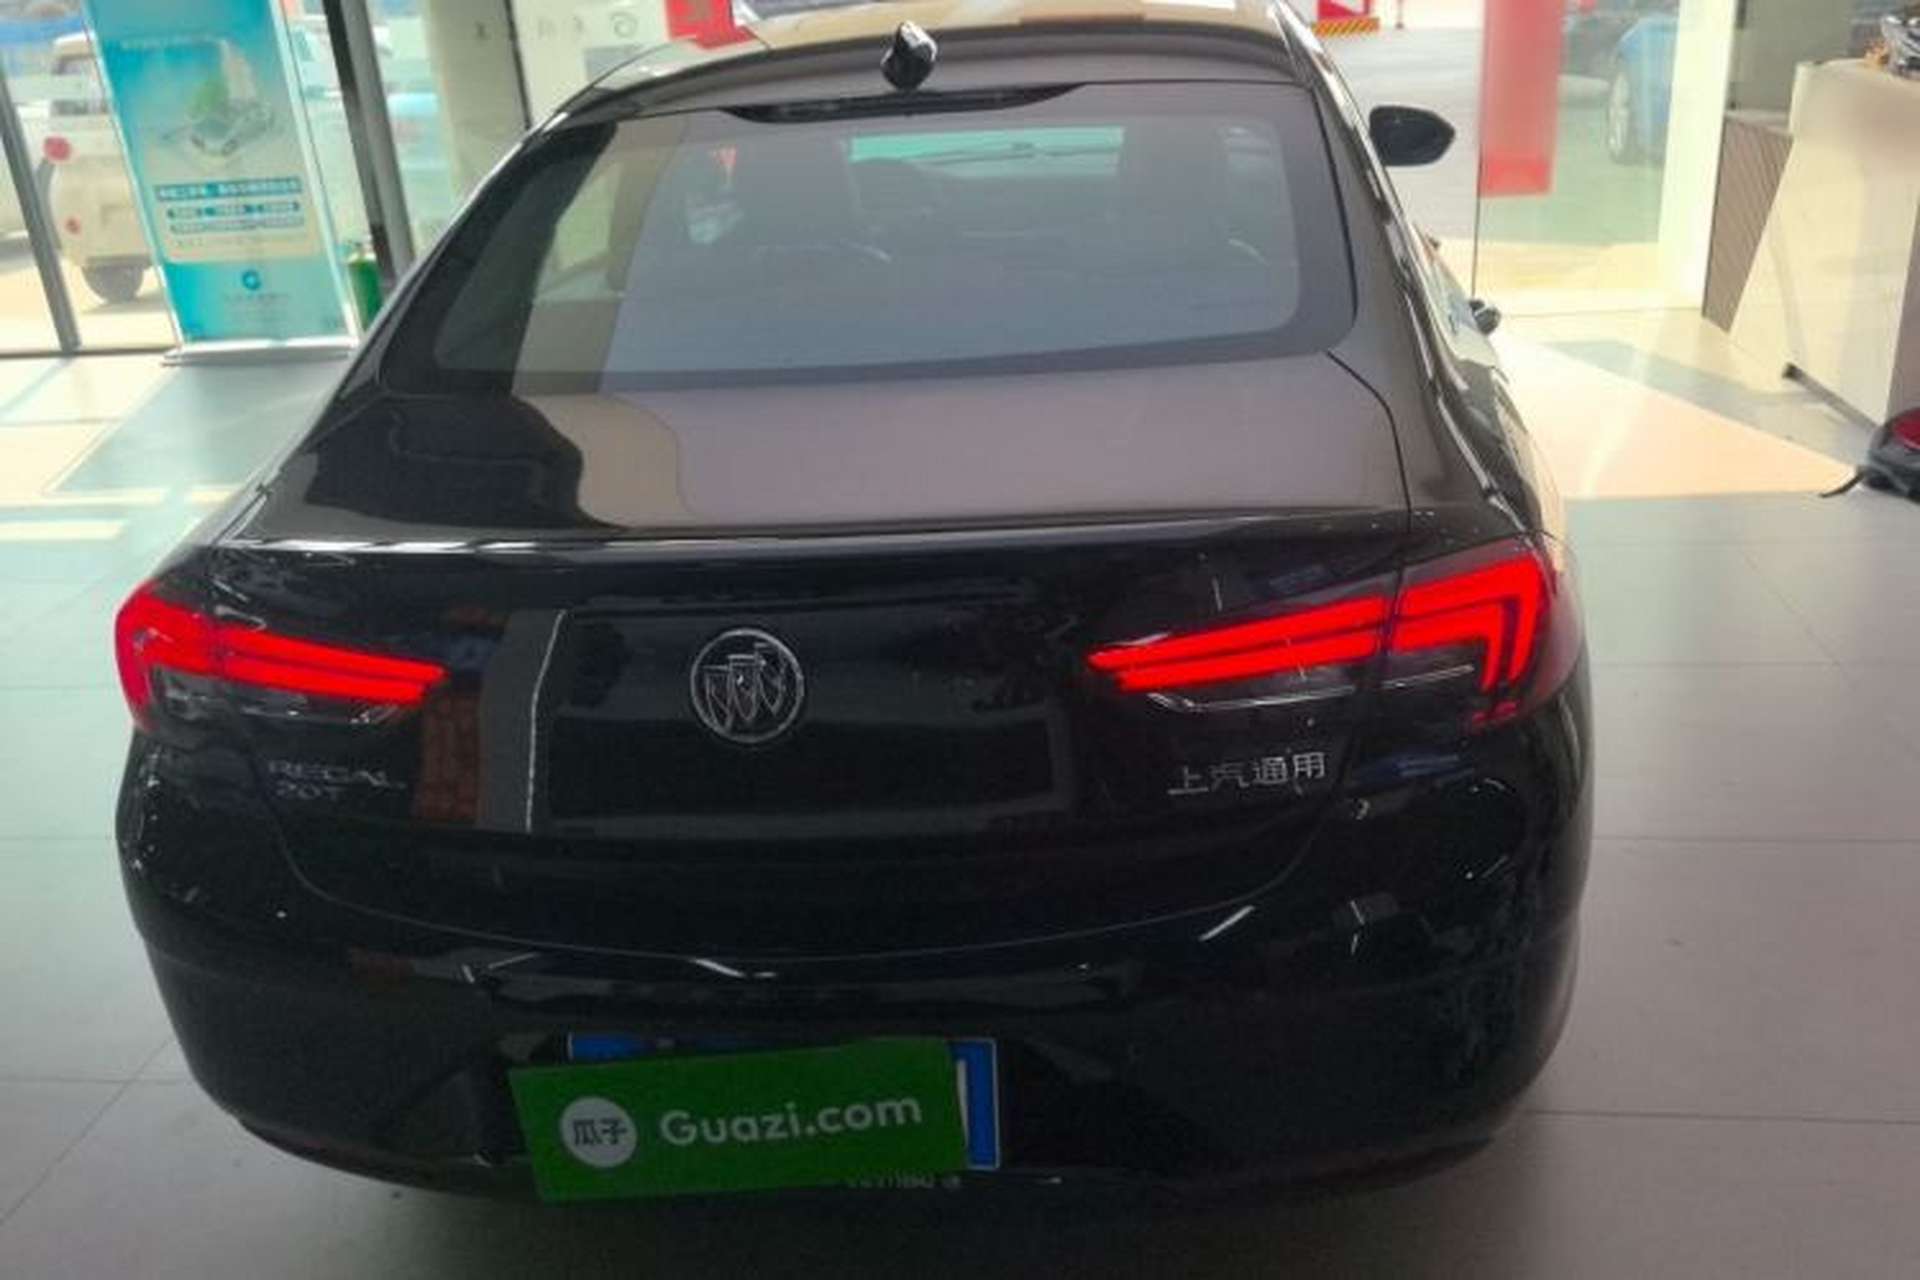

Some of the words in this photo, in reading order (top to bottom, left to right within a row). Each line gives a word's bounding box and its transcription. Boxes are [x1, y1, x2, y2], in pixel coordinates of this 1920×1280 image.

[1166, 752, 1326, 795] 上汽通用
[572, 1117, 628, 1147] 瓜子
[659, 1096, 922, 1147] Guazi.com
